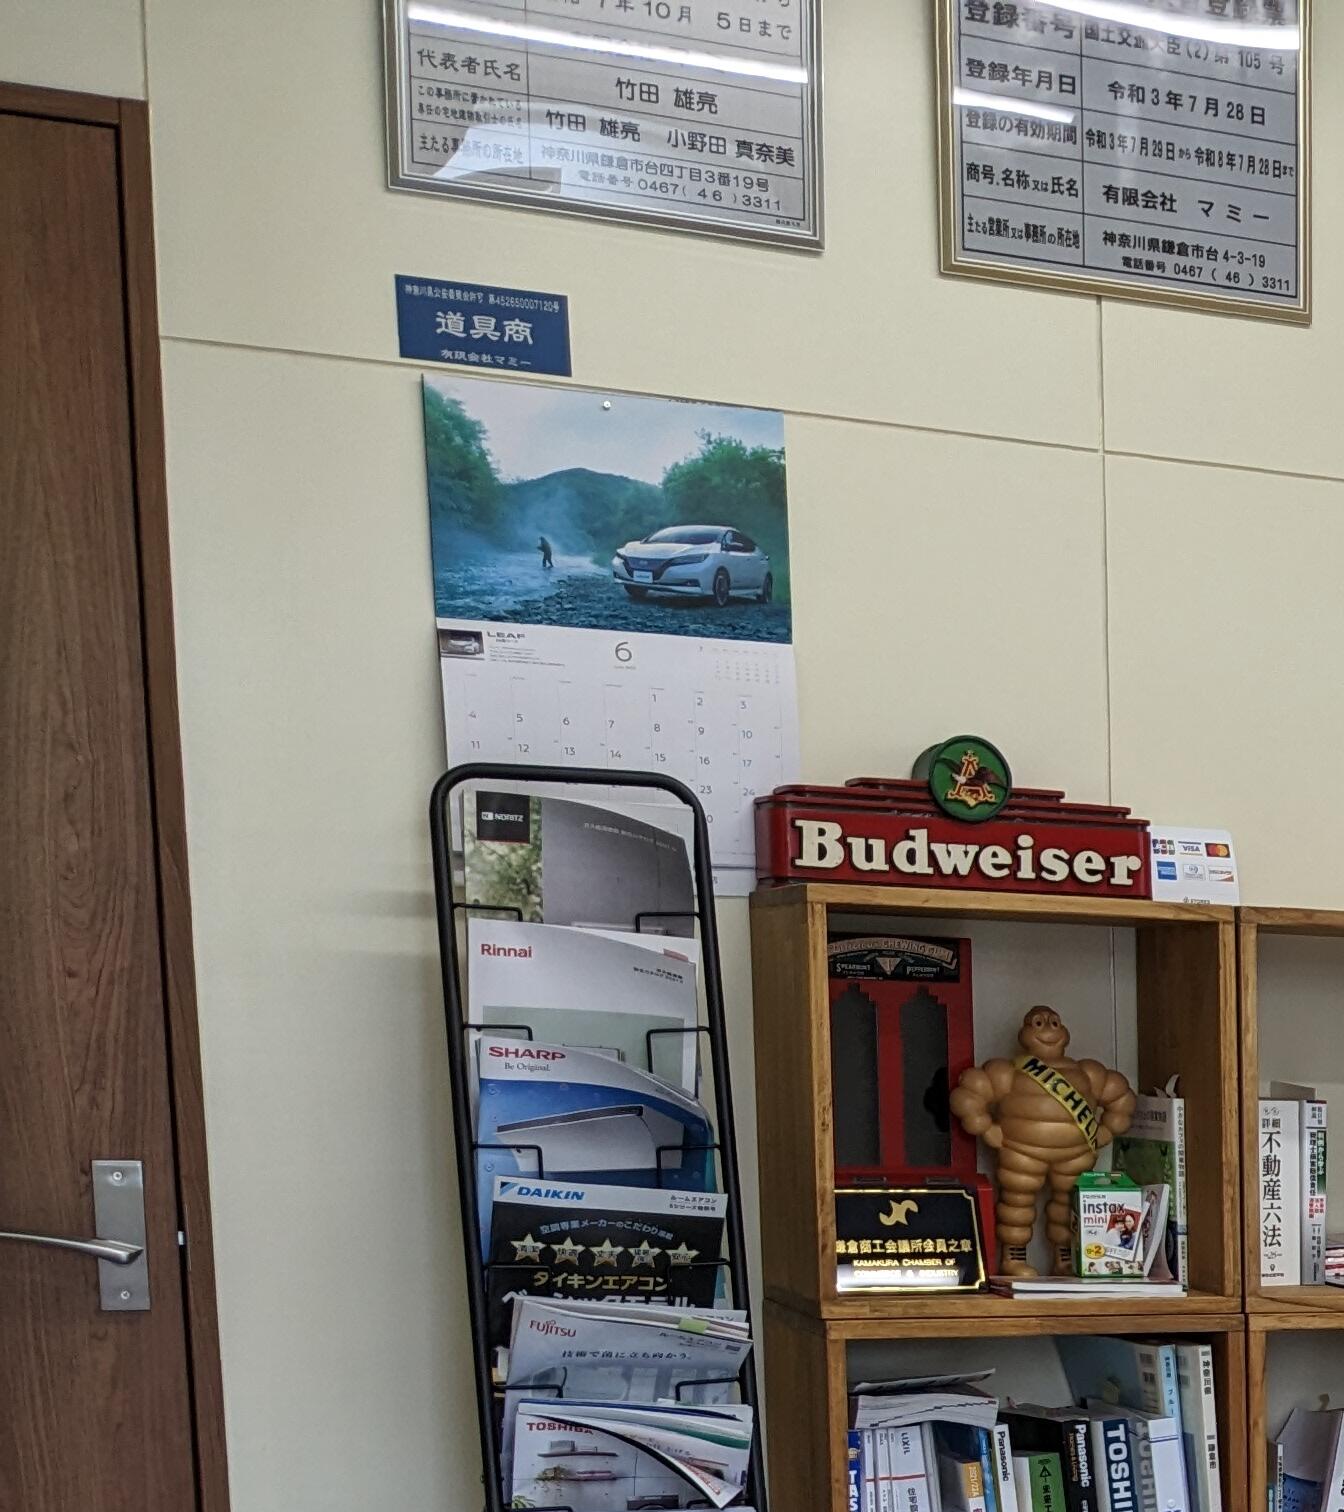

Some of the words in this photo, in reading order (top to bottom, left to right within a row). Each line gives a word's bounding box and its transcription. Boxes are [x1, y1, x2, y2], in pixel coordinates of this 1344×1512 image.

[716, 12, 795, 42] 5日まで
[417, 47, 521, 82] 代表者氏名
[965, 57, 1077, 96] 登録年月日
[615, 76, 660, 104] 竹田
[672, 86, 719, 115] 雄亮
[545, 108, 587, 133] 竹田
[599, 116, 641, 143] 雄亮
[667, 128, 727, 155] 小野田
[735, 138, 796, 168] 真奈美
[966, 110, 1078, 146] 登録の有効期間
[637, 179, 681, 196] 0467
[742, 193, 782, 212] 3311
[1102, 184, 1178, 214] 有限会社
[1197, 199, 1270, 223] マミー
[967, 212, 1081, 250] 主たる営業所又は事務所の所在地
[1122, 256, 1167, 275] 電話番号
[1173, 261, 1203, 279] 0467
[1262, 276, 1291, 292] 3311
[435, 311, 534, 345] 道具商
[440, 349, 532, 367] 有限会社マミー
[486, 630, 526, 640] LEAF
[614, 641, 633, 662] 6
[696, 697, 704, 706] 2
[740, 700, 747, 709] 3
[516, 714, 523, 722] 5
[563, 717, 570, 725] 6
[607, 719, 615, 728] 7
[653, 723, 661, 732] 8
[697, 726, 705, 735] 9
[741, 730, 753, 739] 10
[471, 741, 481, 749] 11
[518, 743, 530, 752] 12
[564, 747, 576, 756] 13
[610, 750, 622, 759] 14
[654, 753, 667, 762] 15
[699, 756, 710, 765] 16
[742, 759, 752, 768] 17
[699, 785, 712, 794] 23
[743, 788, 756, 796] 24
[794, 818, 1143, 888] Budweiser
[1182, 844, 1201, 852] VISA
[480, 943, 533, 958] Rinnai
[488, 1046, 566, 1061] SHARP
[504, 1061, 514, 1071] Be
[516, 1186, 585, 1201] DAIKIN
[1261, 1130, 1283, 1248] 不動産六法
[1082, 1200, 1126, 1215] instax
[1083, 1214, 1108, 1225] mini
[853, 1258, 900, 1267] KAMAKURA
[902, 1258, 942, 1266] CHAMBER
[944, 1258, 956, 1266] OF
[529, 1318, 577, 1338] FUJITSU
[526, 1421, 594, 1436] TOSHIBA
[901, 1433, 911, 1455] LIXIL
[997, 1430, 1010, 1482] Panasonic
[1074, 1423, 1090, 1489] Panasonic
